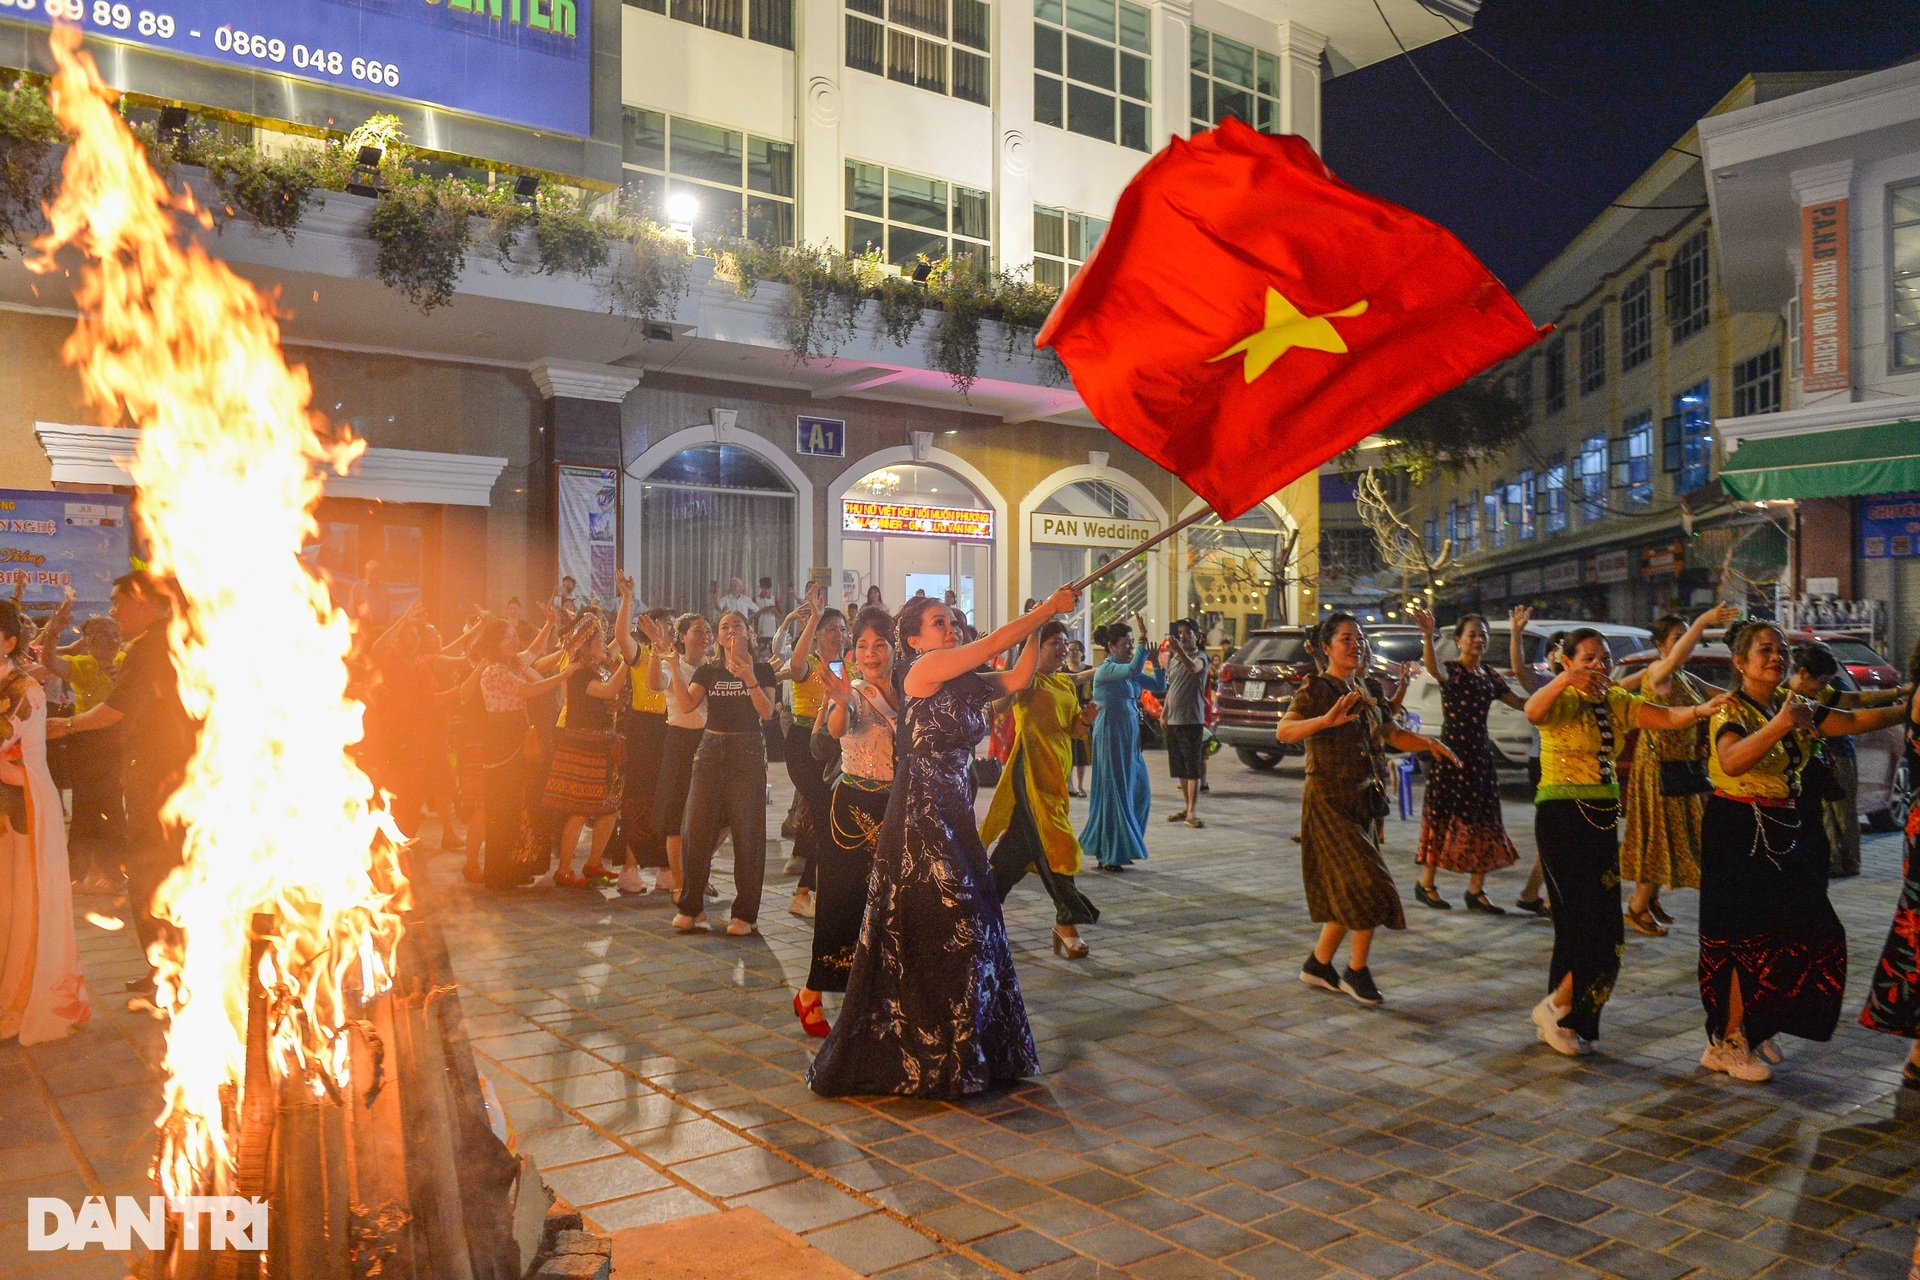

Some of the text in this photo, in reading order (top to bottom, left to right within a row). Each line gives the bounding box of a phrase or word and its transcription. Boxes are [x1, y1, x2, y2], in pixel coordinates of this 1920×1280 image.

[93, 1, 131, 29] 89
[138, 11, 175, 38] 89
[214, 27, 286, 62] 0869
[292, 44, 343, 75] 048
[351, 57, 400, 87] 666
[808, 424, 834, 450] A1
[1043, 519, 1149, 543] PAN Wedding
